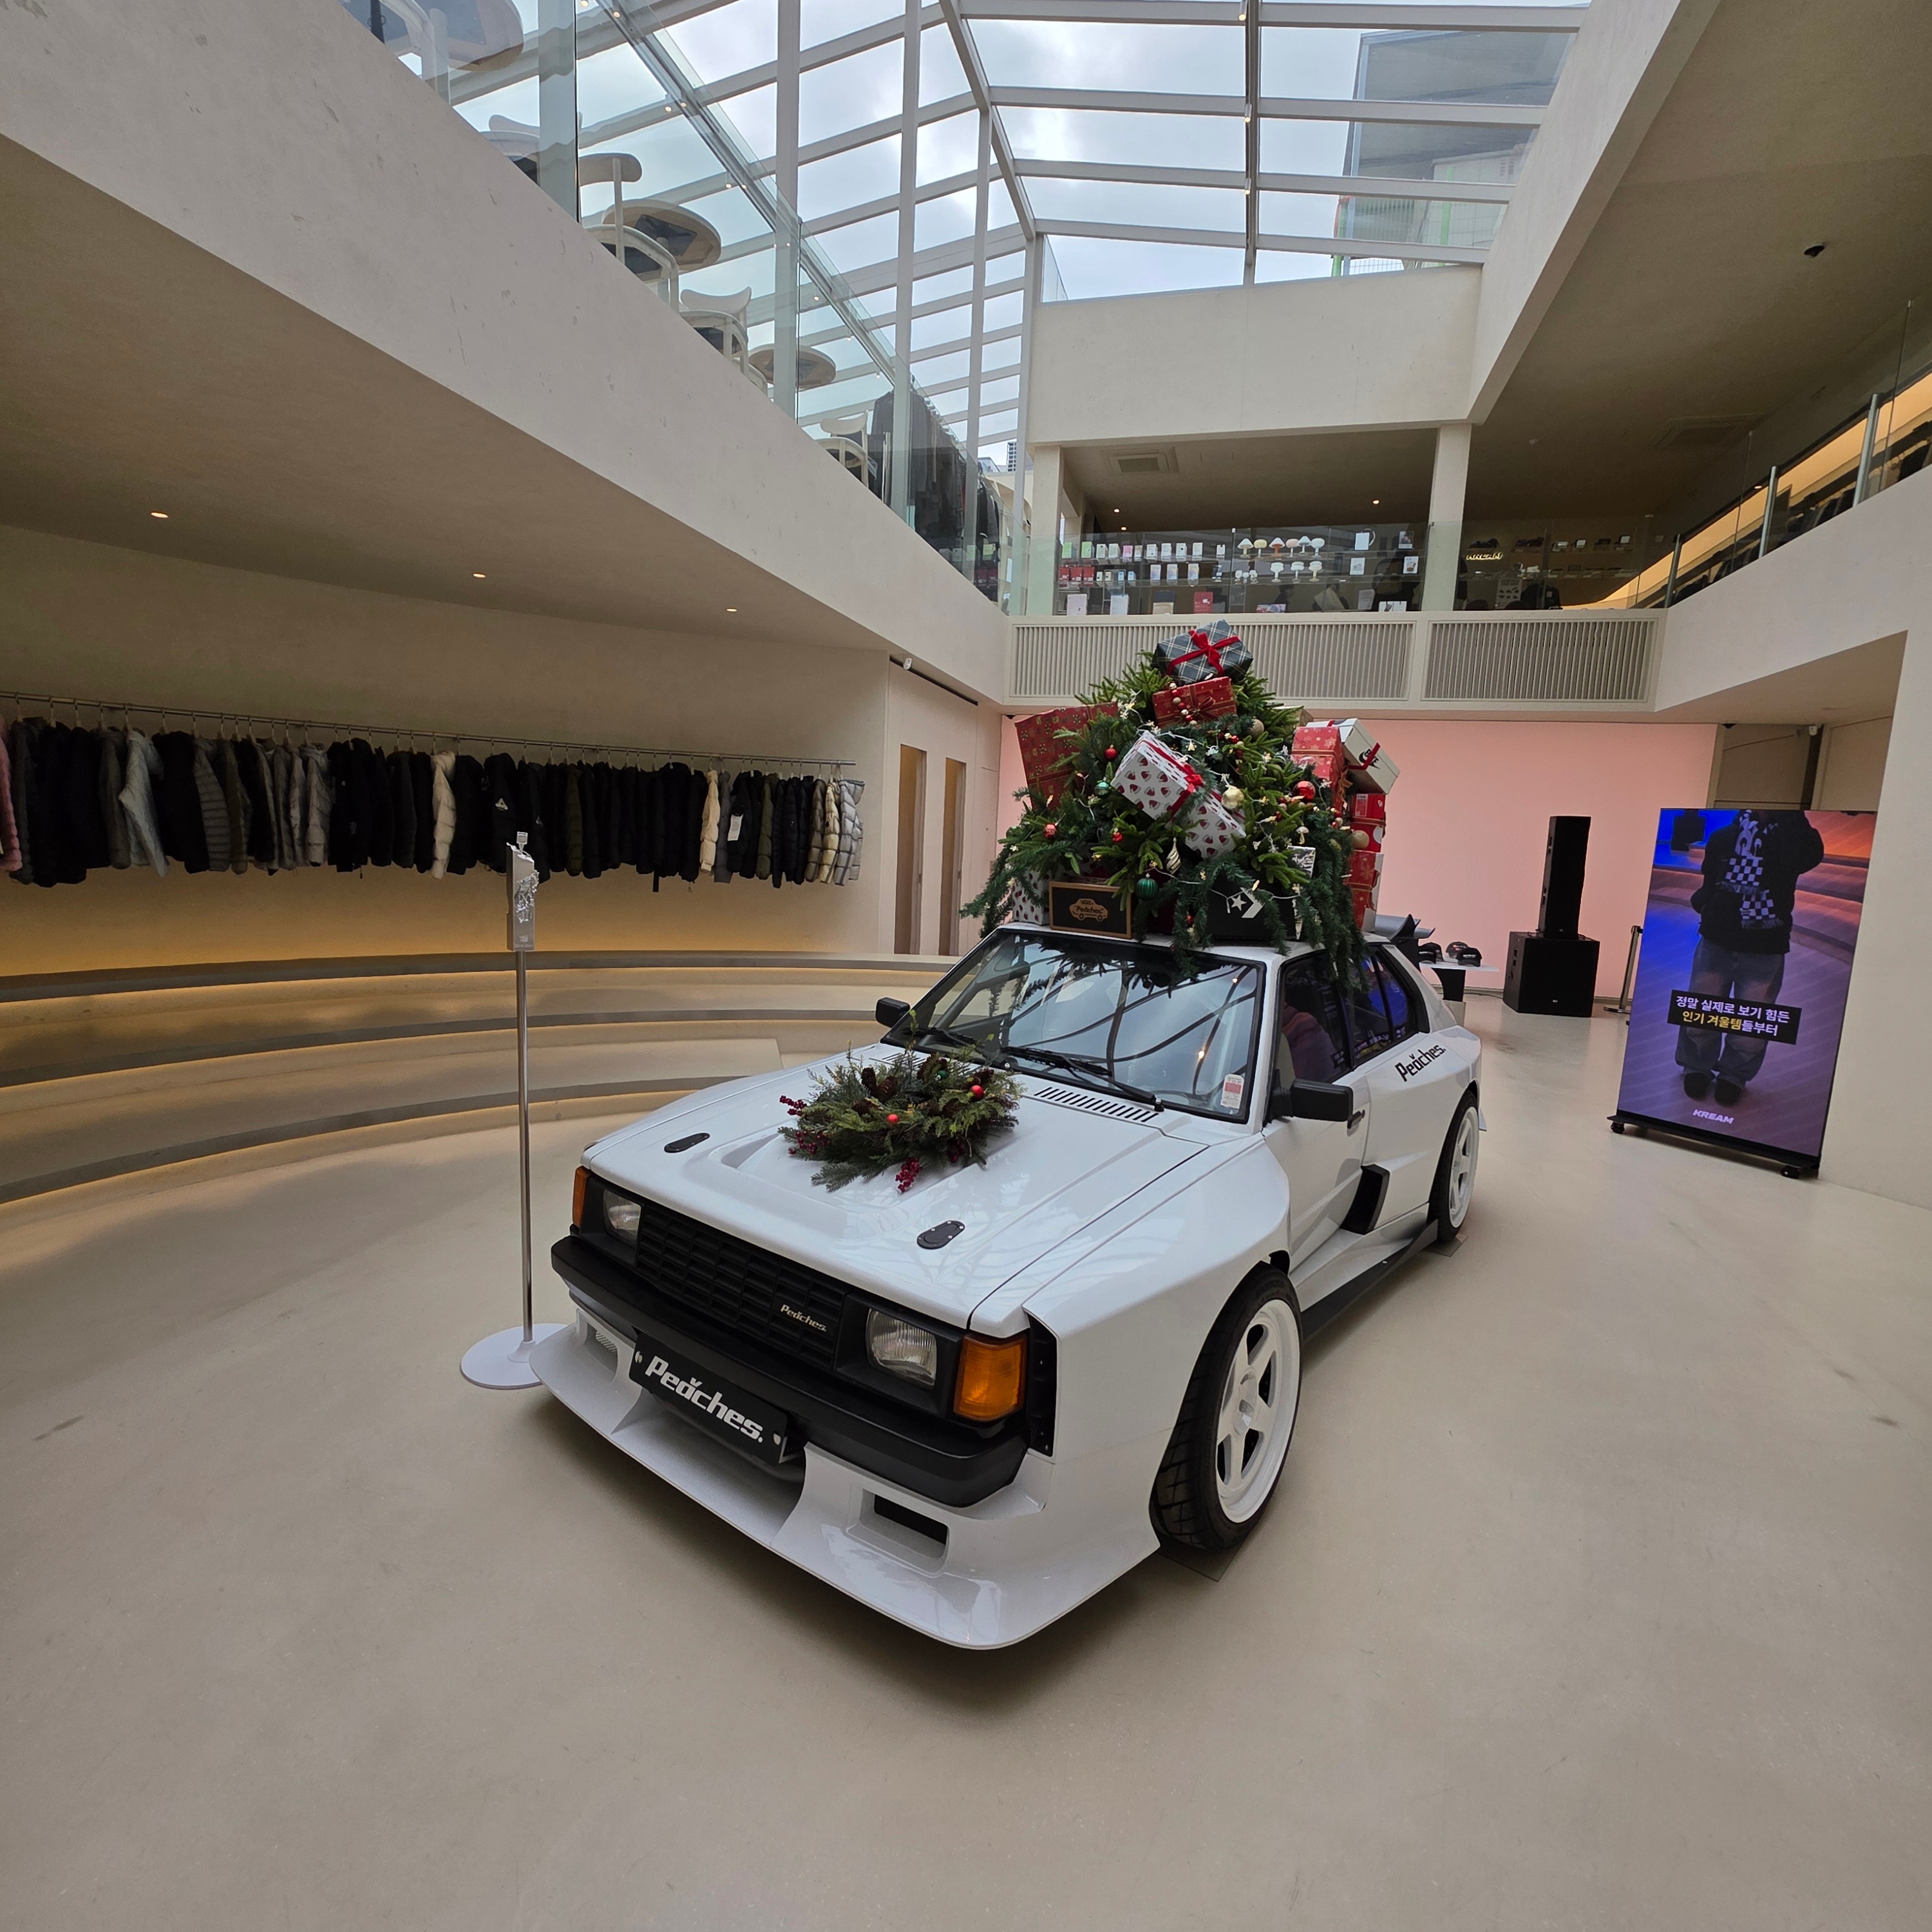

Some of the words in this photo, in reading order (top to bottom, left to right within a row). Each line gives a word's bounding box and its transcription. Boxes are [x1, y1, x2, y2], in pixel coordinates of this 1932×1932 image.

[1676, 996, 1698, 1009] 정말
[1701, 999, 1736, 1015] 실제로
[1737, 1005, 1762, 1019] 보기
[1765, 1008, 1790, 1023] 힘든
[1682, 1010, 1704, 1025] 인기
[1707, 1014, 1779, 1036] 겨울템들부터
[1692, 1109, 1734, 1124] KREAM
